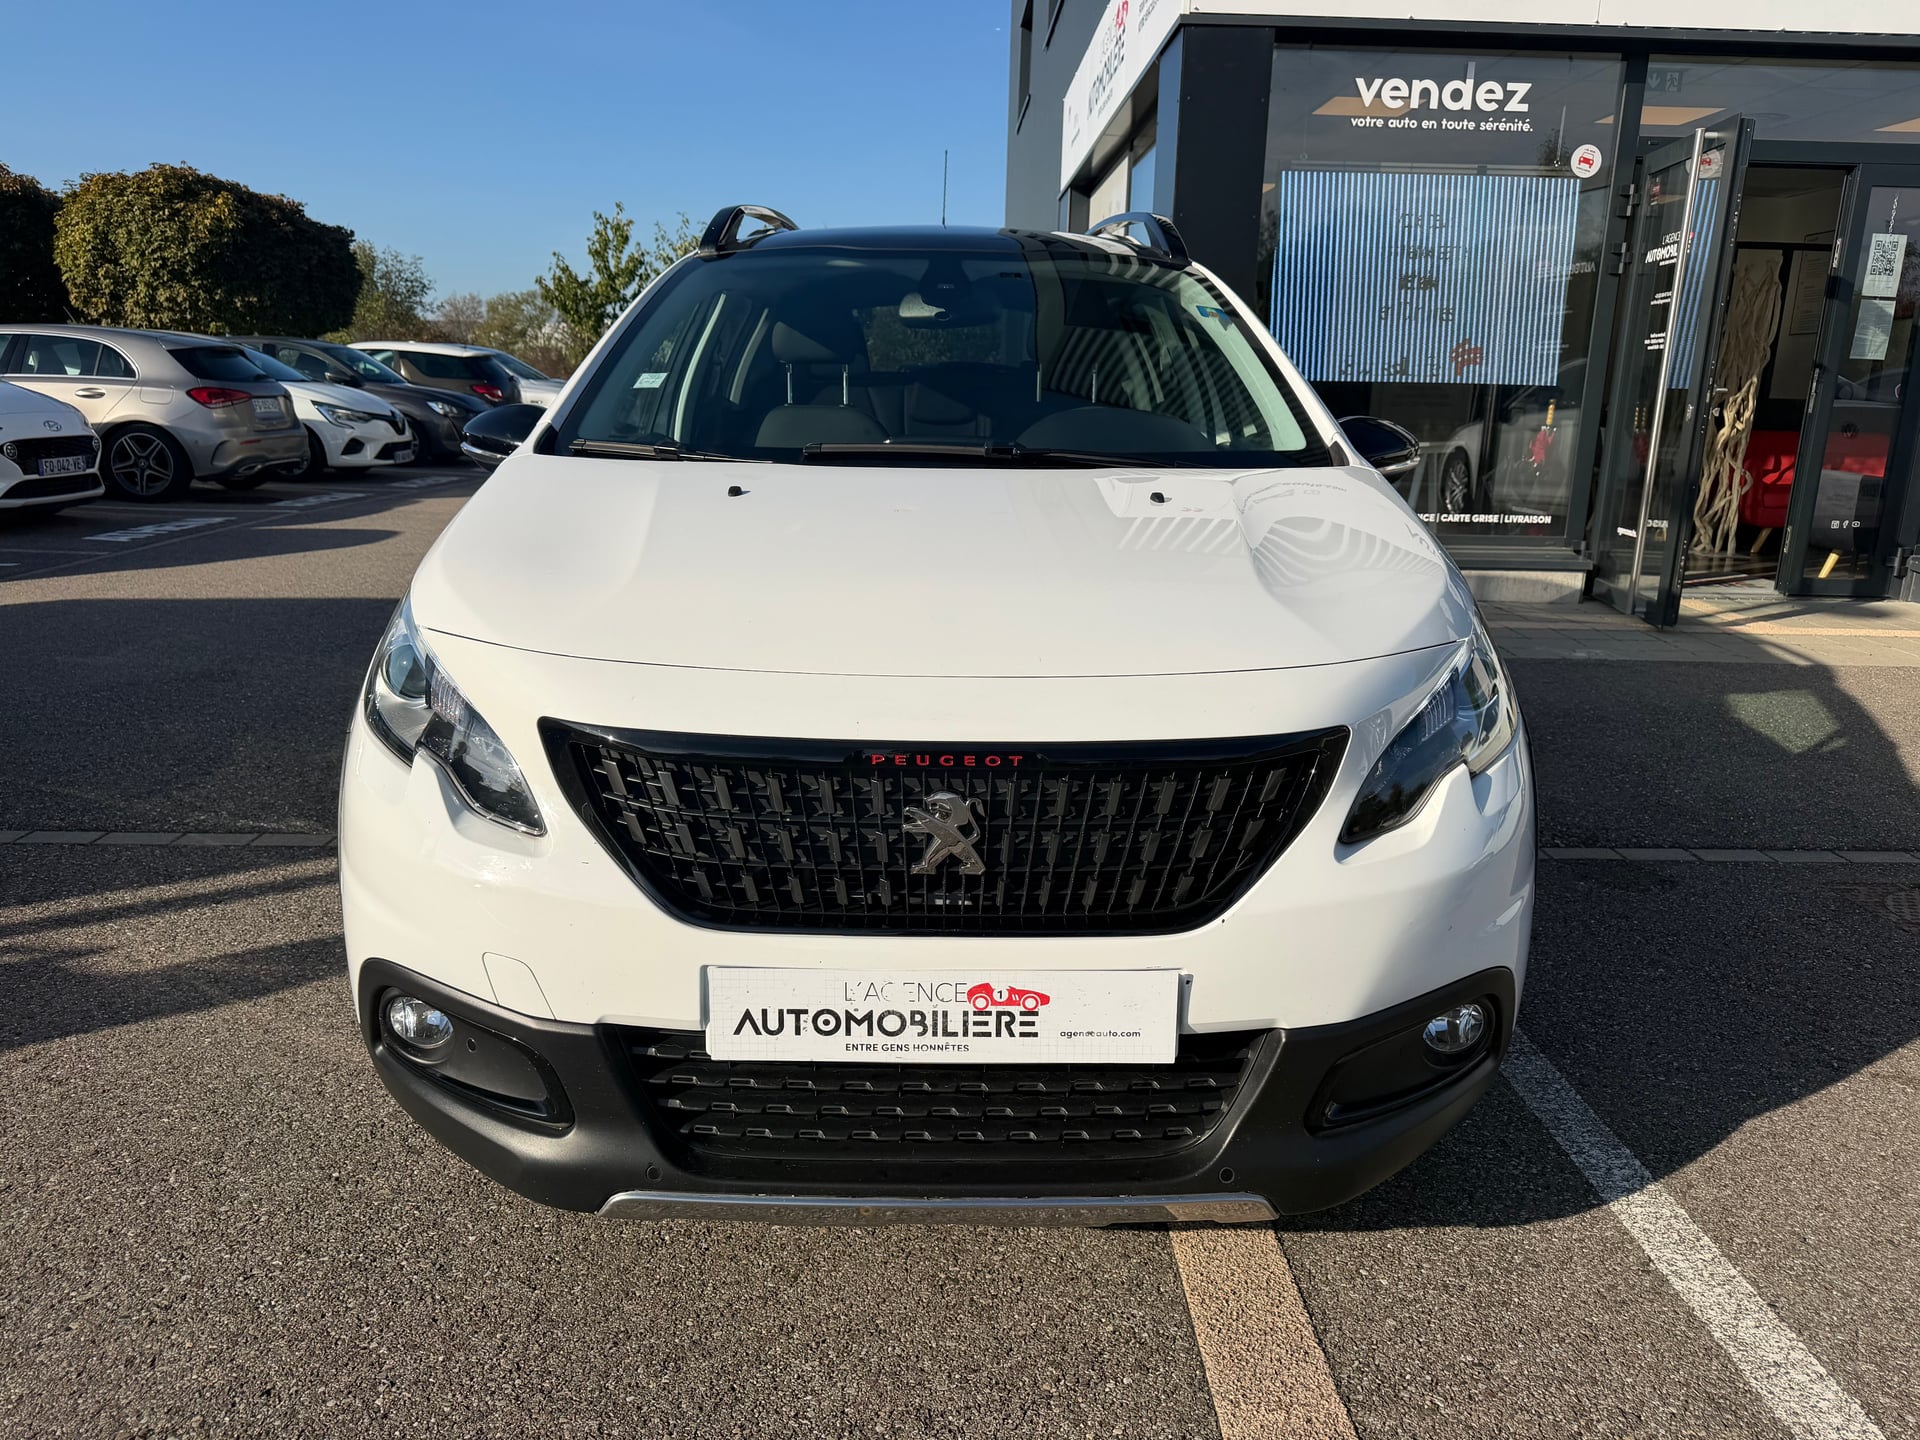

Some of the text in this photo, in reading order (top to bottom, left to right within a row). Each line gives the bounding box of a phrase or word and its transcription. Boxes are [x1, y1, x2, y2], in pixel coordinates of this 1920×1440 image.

[1355, 61, 1532, 112] vendez
[1351, 116, 1534, 132] votre auto en toute sérénité.
[1440, 513, 1471, 523] CARTE
[1472, 514, 1499, 523] GRISE
[1504, 515, 1552, 524] LIVRAISON
[871, 754, 1023, 767] PEUGEOT
[997, 989, 1004, 1000] 1
[733, 1007, 1039, 1038] AUTOMOBILIERE
[845, 1041, 970, 1053] ENTRE GENS HONNÊTES
